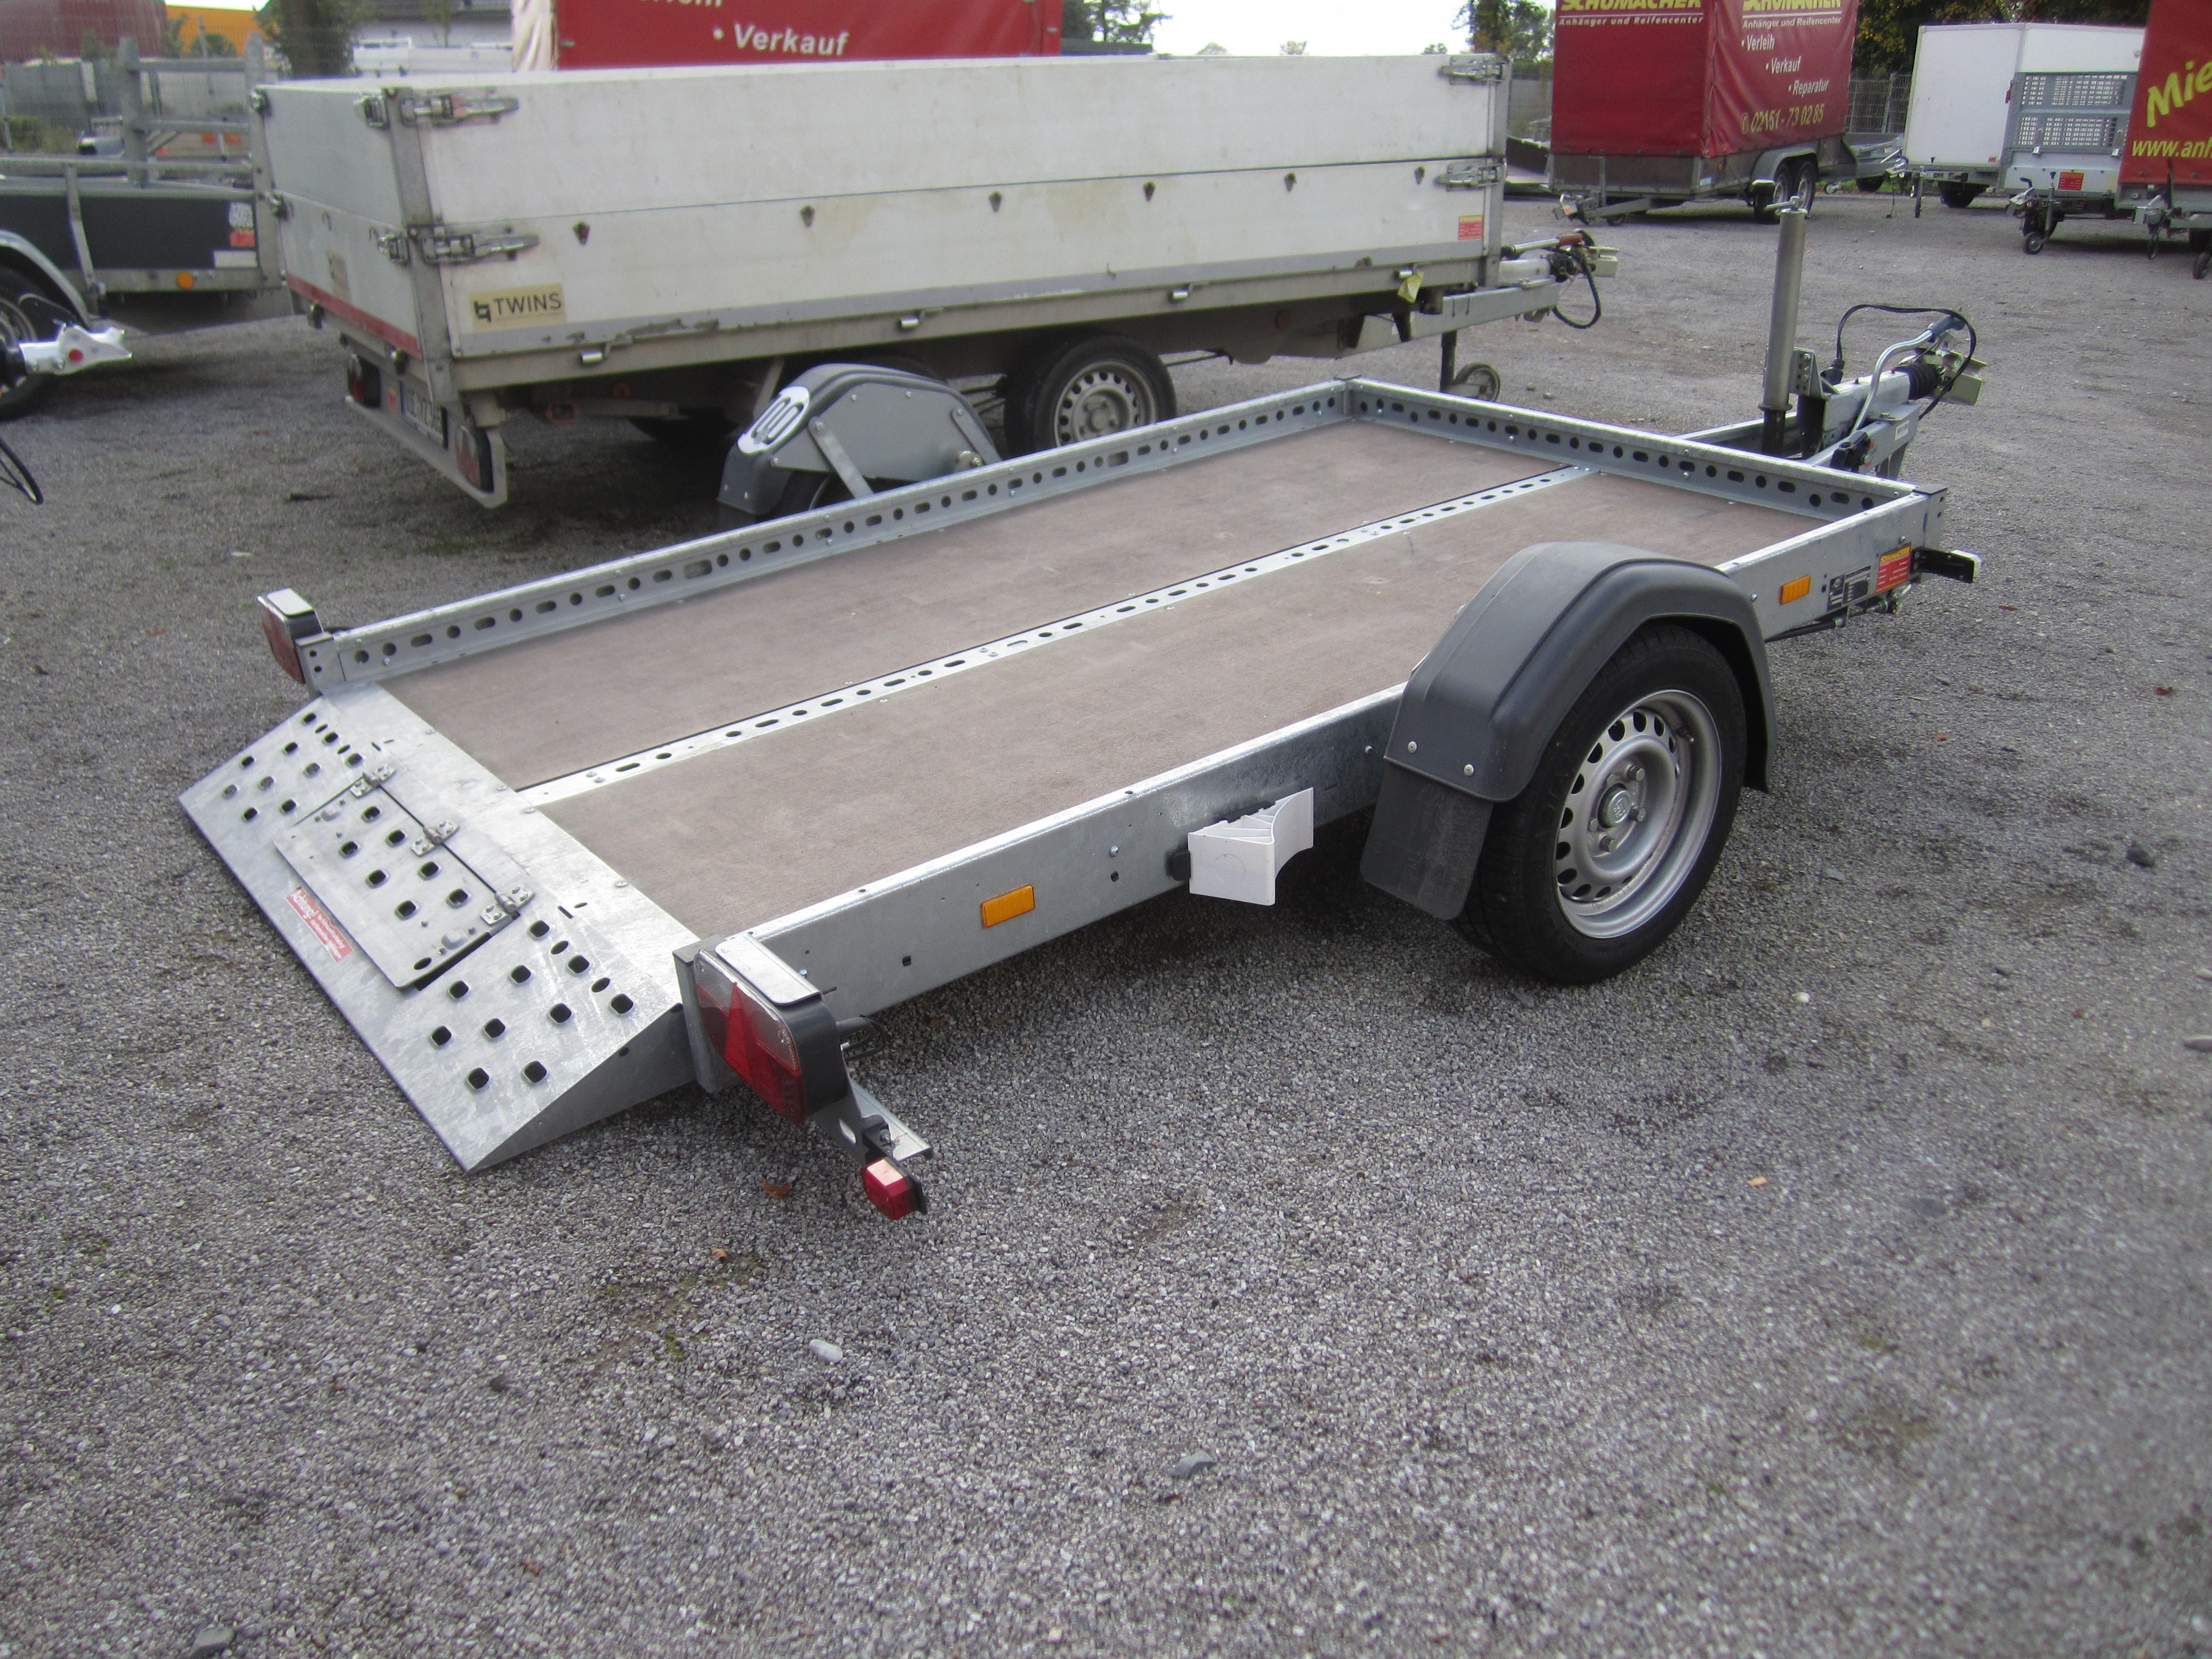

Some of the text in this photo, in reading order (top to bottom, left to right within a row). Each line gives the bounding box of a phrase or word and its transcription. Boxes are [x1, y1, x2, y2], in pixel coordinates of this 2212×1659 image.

[1559, 16, 1704, 27] Anhänger und Reifencenter
[1742, 16, 1842, 29] Anhänger und Reifencenter
[734, 22, 850, 56] Verkauf
[1747, 34, 1775, 51] Verleih
[1771, 55, 1802, 74] Verkauf
[1793, 78, 1830, 98] Reparatur
[1751, 109, 1781, 133] 02151
[1786, 107, 1800, 127] 73
[1800, 104, 1813, 126] 02
[1813, 102, 1825, 124] 85
[493, 292, 562, 315] TWINS
